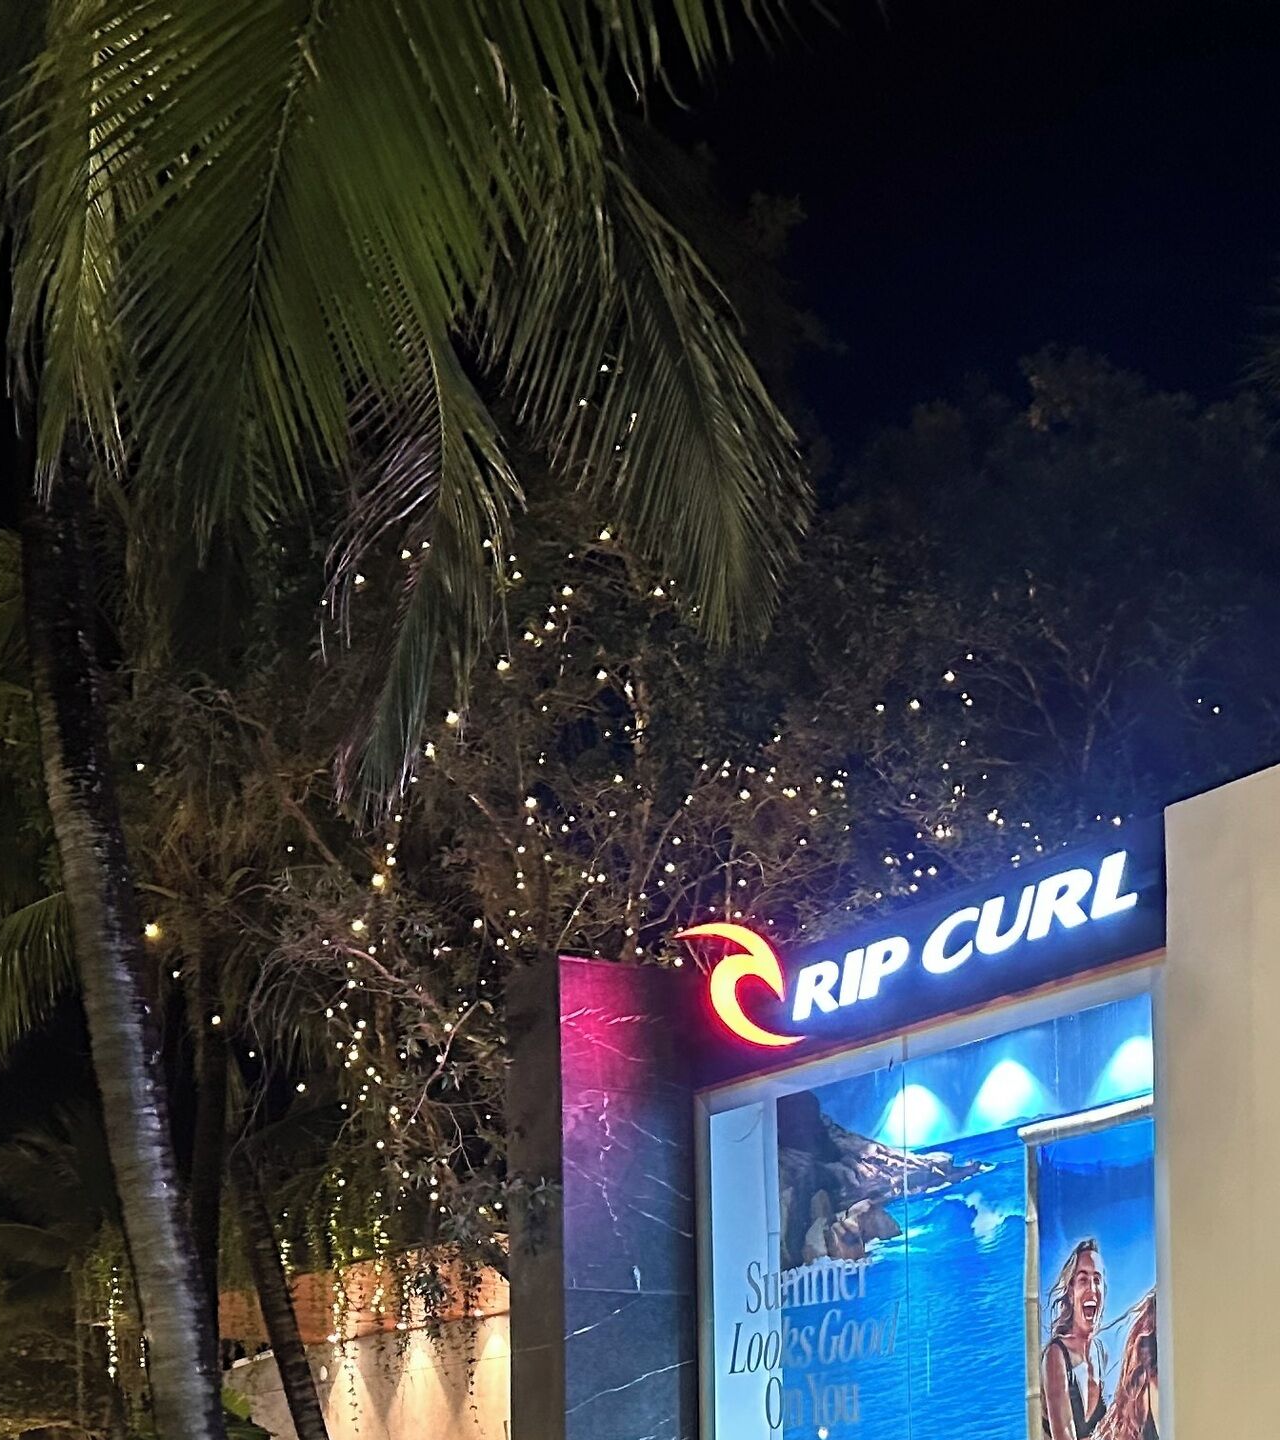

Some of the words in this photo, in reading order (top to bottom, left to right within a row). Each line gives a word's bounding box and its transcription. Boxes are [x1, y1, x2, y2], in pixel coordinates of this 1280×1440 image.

[791, 935, 910, 1022] RIP
[921, 850, 1138, 974] CURL
[746, 1257, 871, 1314] Summer
[728, 1315, 816, 1374] Looks
[817, 1300, 903, 1367] Good
[765, 1377, 803, 1429] On
[806, 1373, 861, 1427] You
